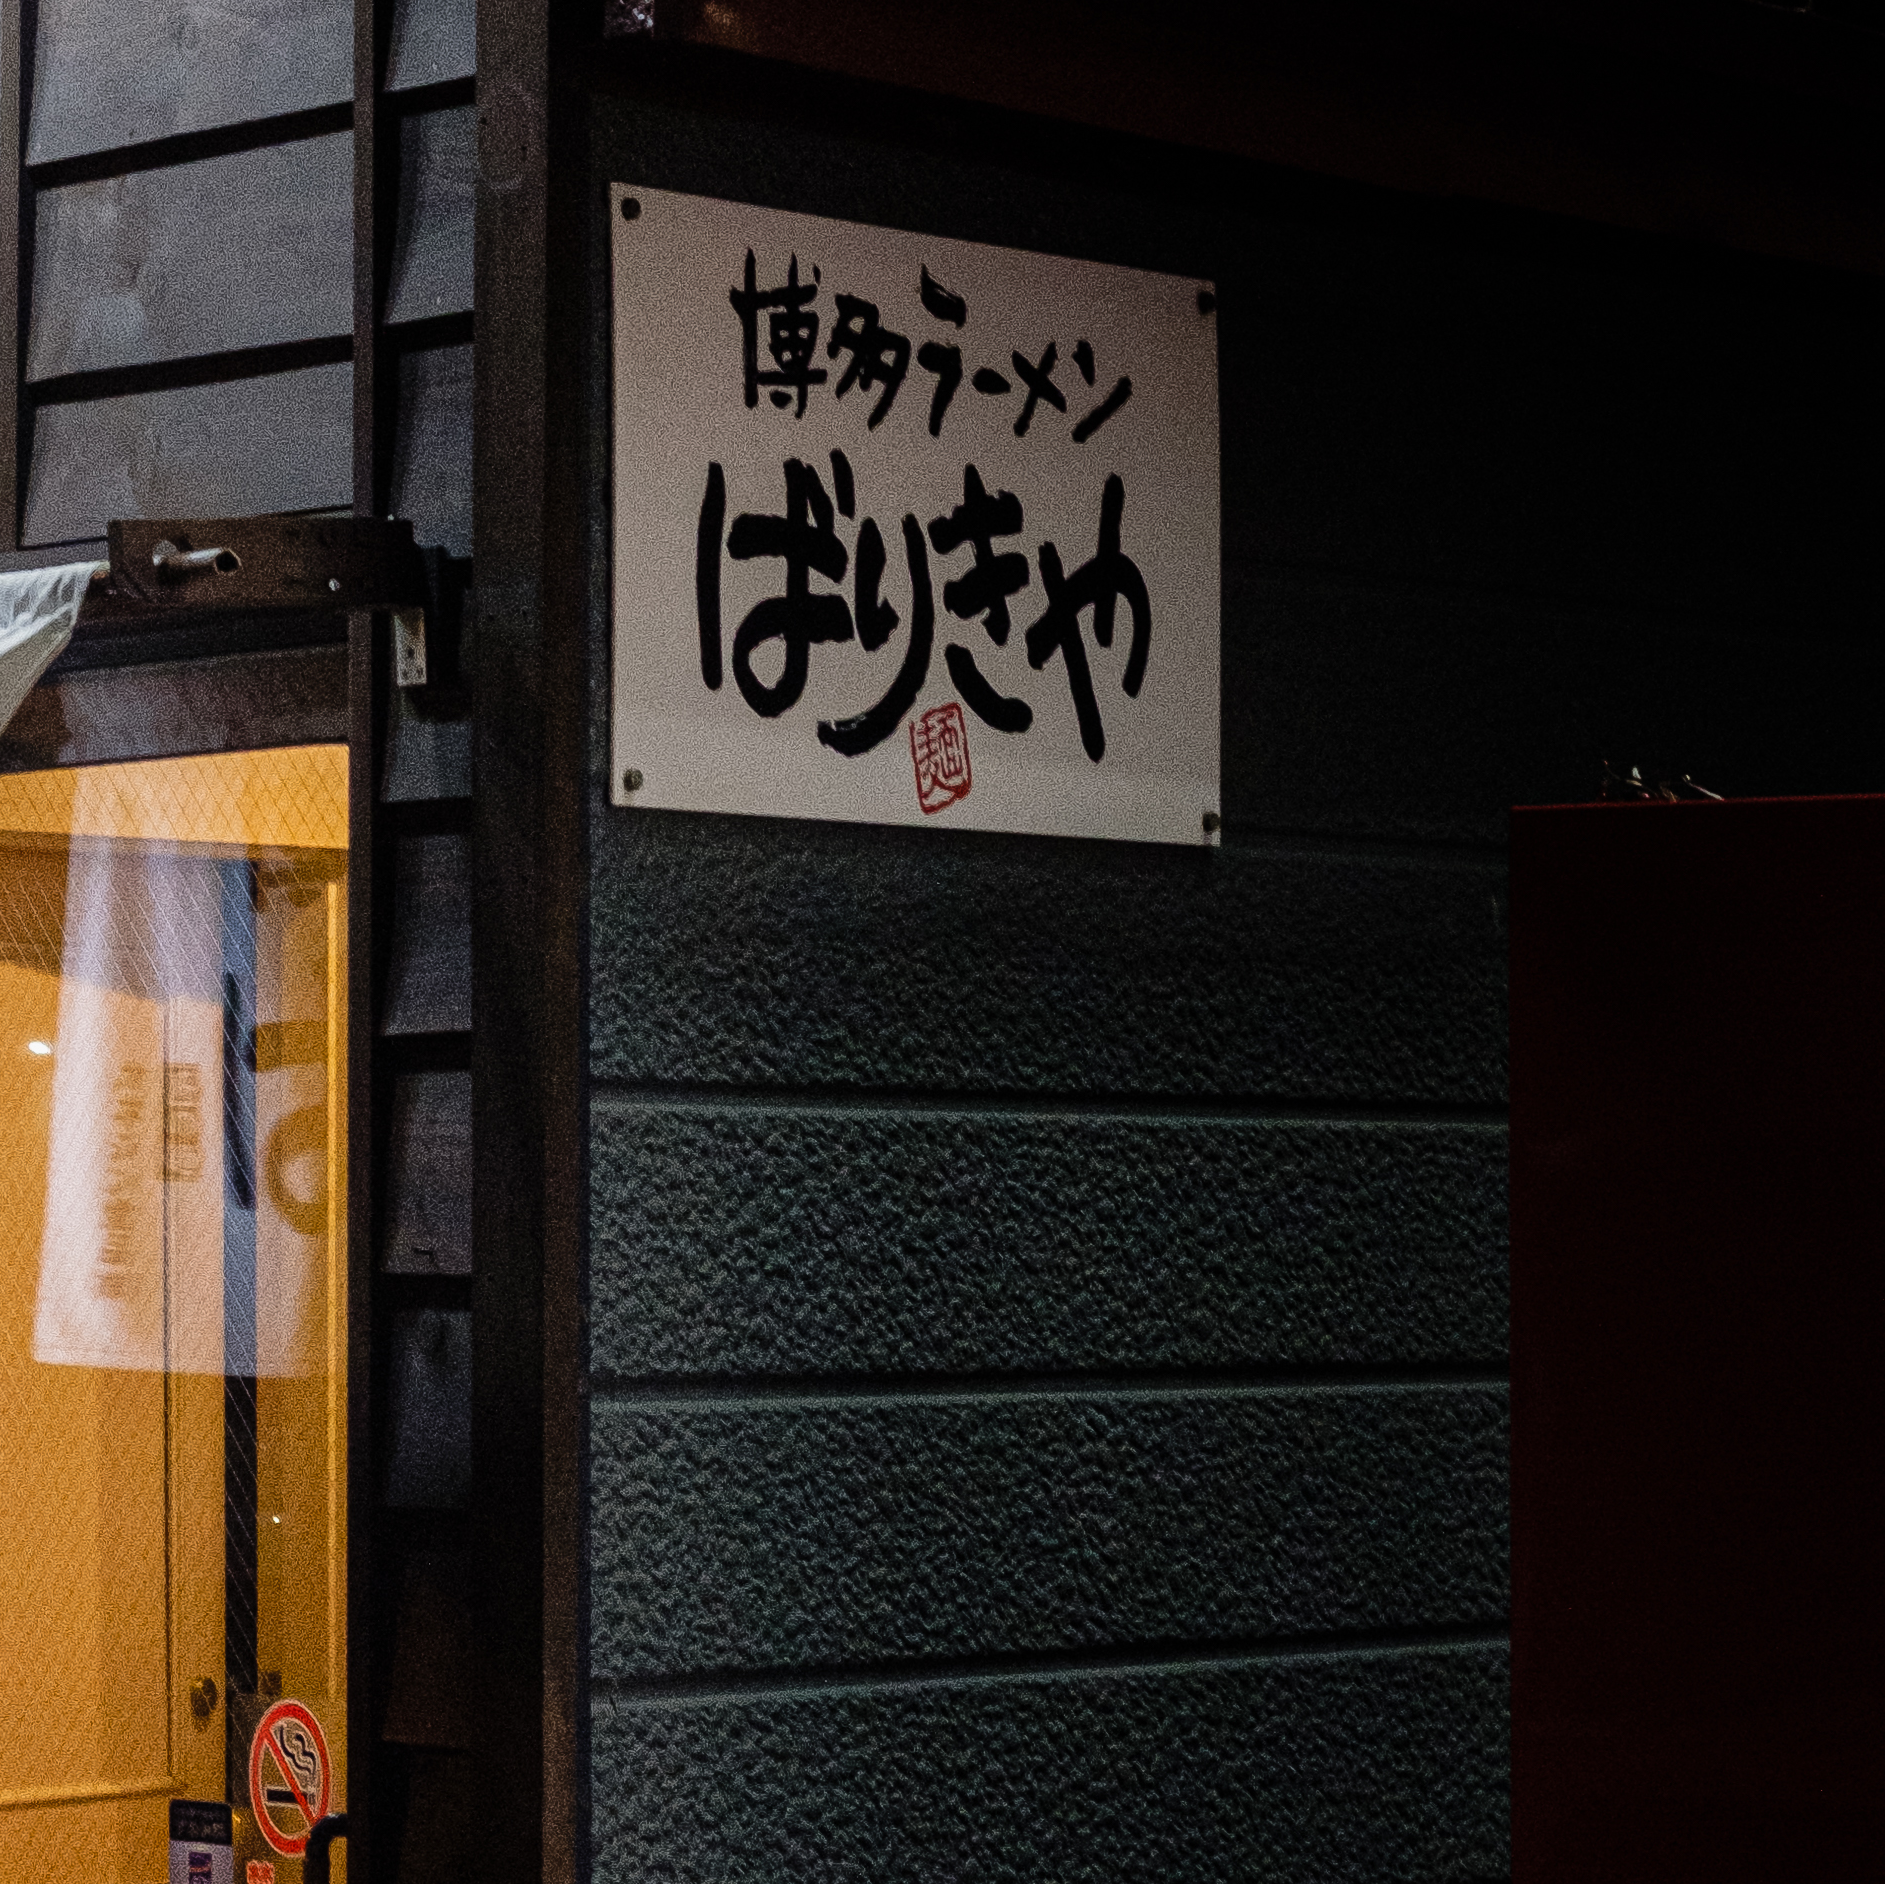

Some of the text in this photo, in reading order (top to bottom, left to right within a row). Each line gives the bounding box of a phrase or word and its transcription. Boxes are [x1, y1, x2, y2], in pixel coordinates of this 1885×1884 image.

[728, 246, 1134, 445] 博多ラーメン
[695, 447, 1154, 764] ばりきや
